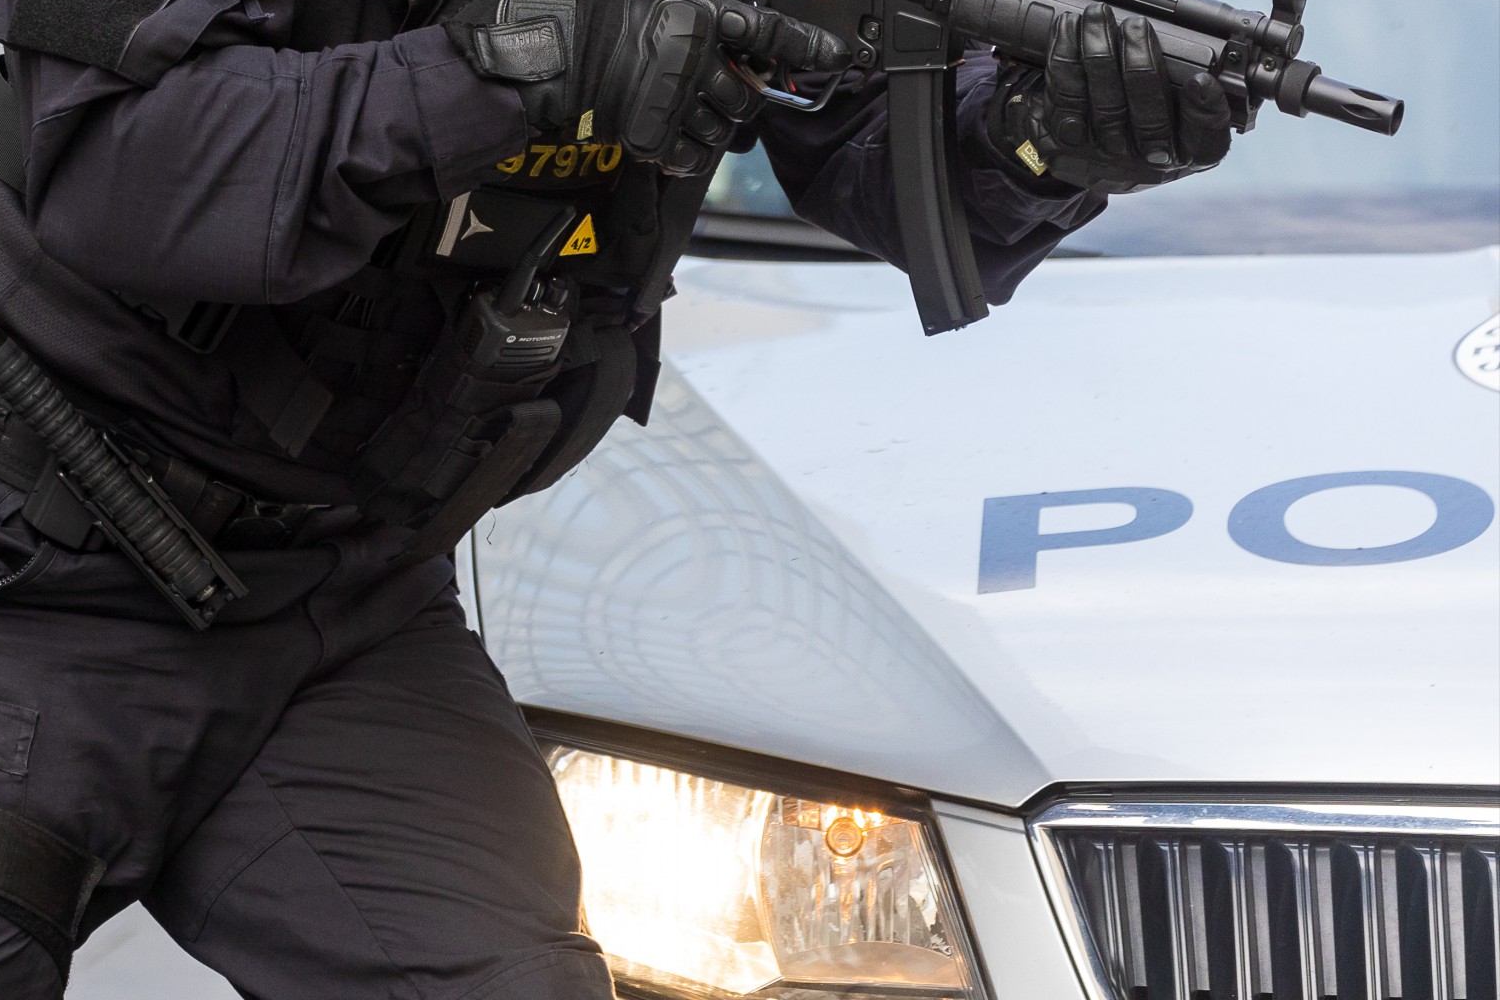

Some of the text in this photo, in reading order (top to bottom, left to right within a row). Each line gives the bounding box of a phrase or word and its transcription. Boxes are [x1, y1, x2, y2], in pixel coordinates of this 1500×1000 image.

[570, 237, 592, 252] 4/2
[518, 334, 562, 343] MOTOROLA
[977, 470, 1495, 595] PO
